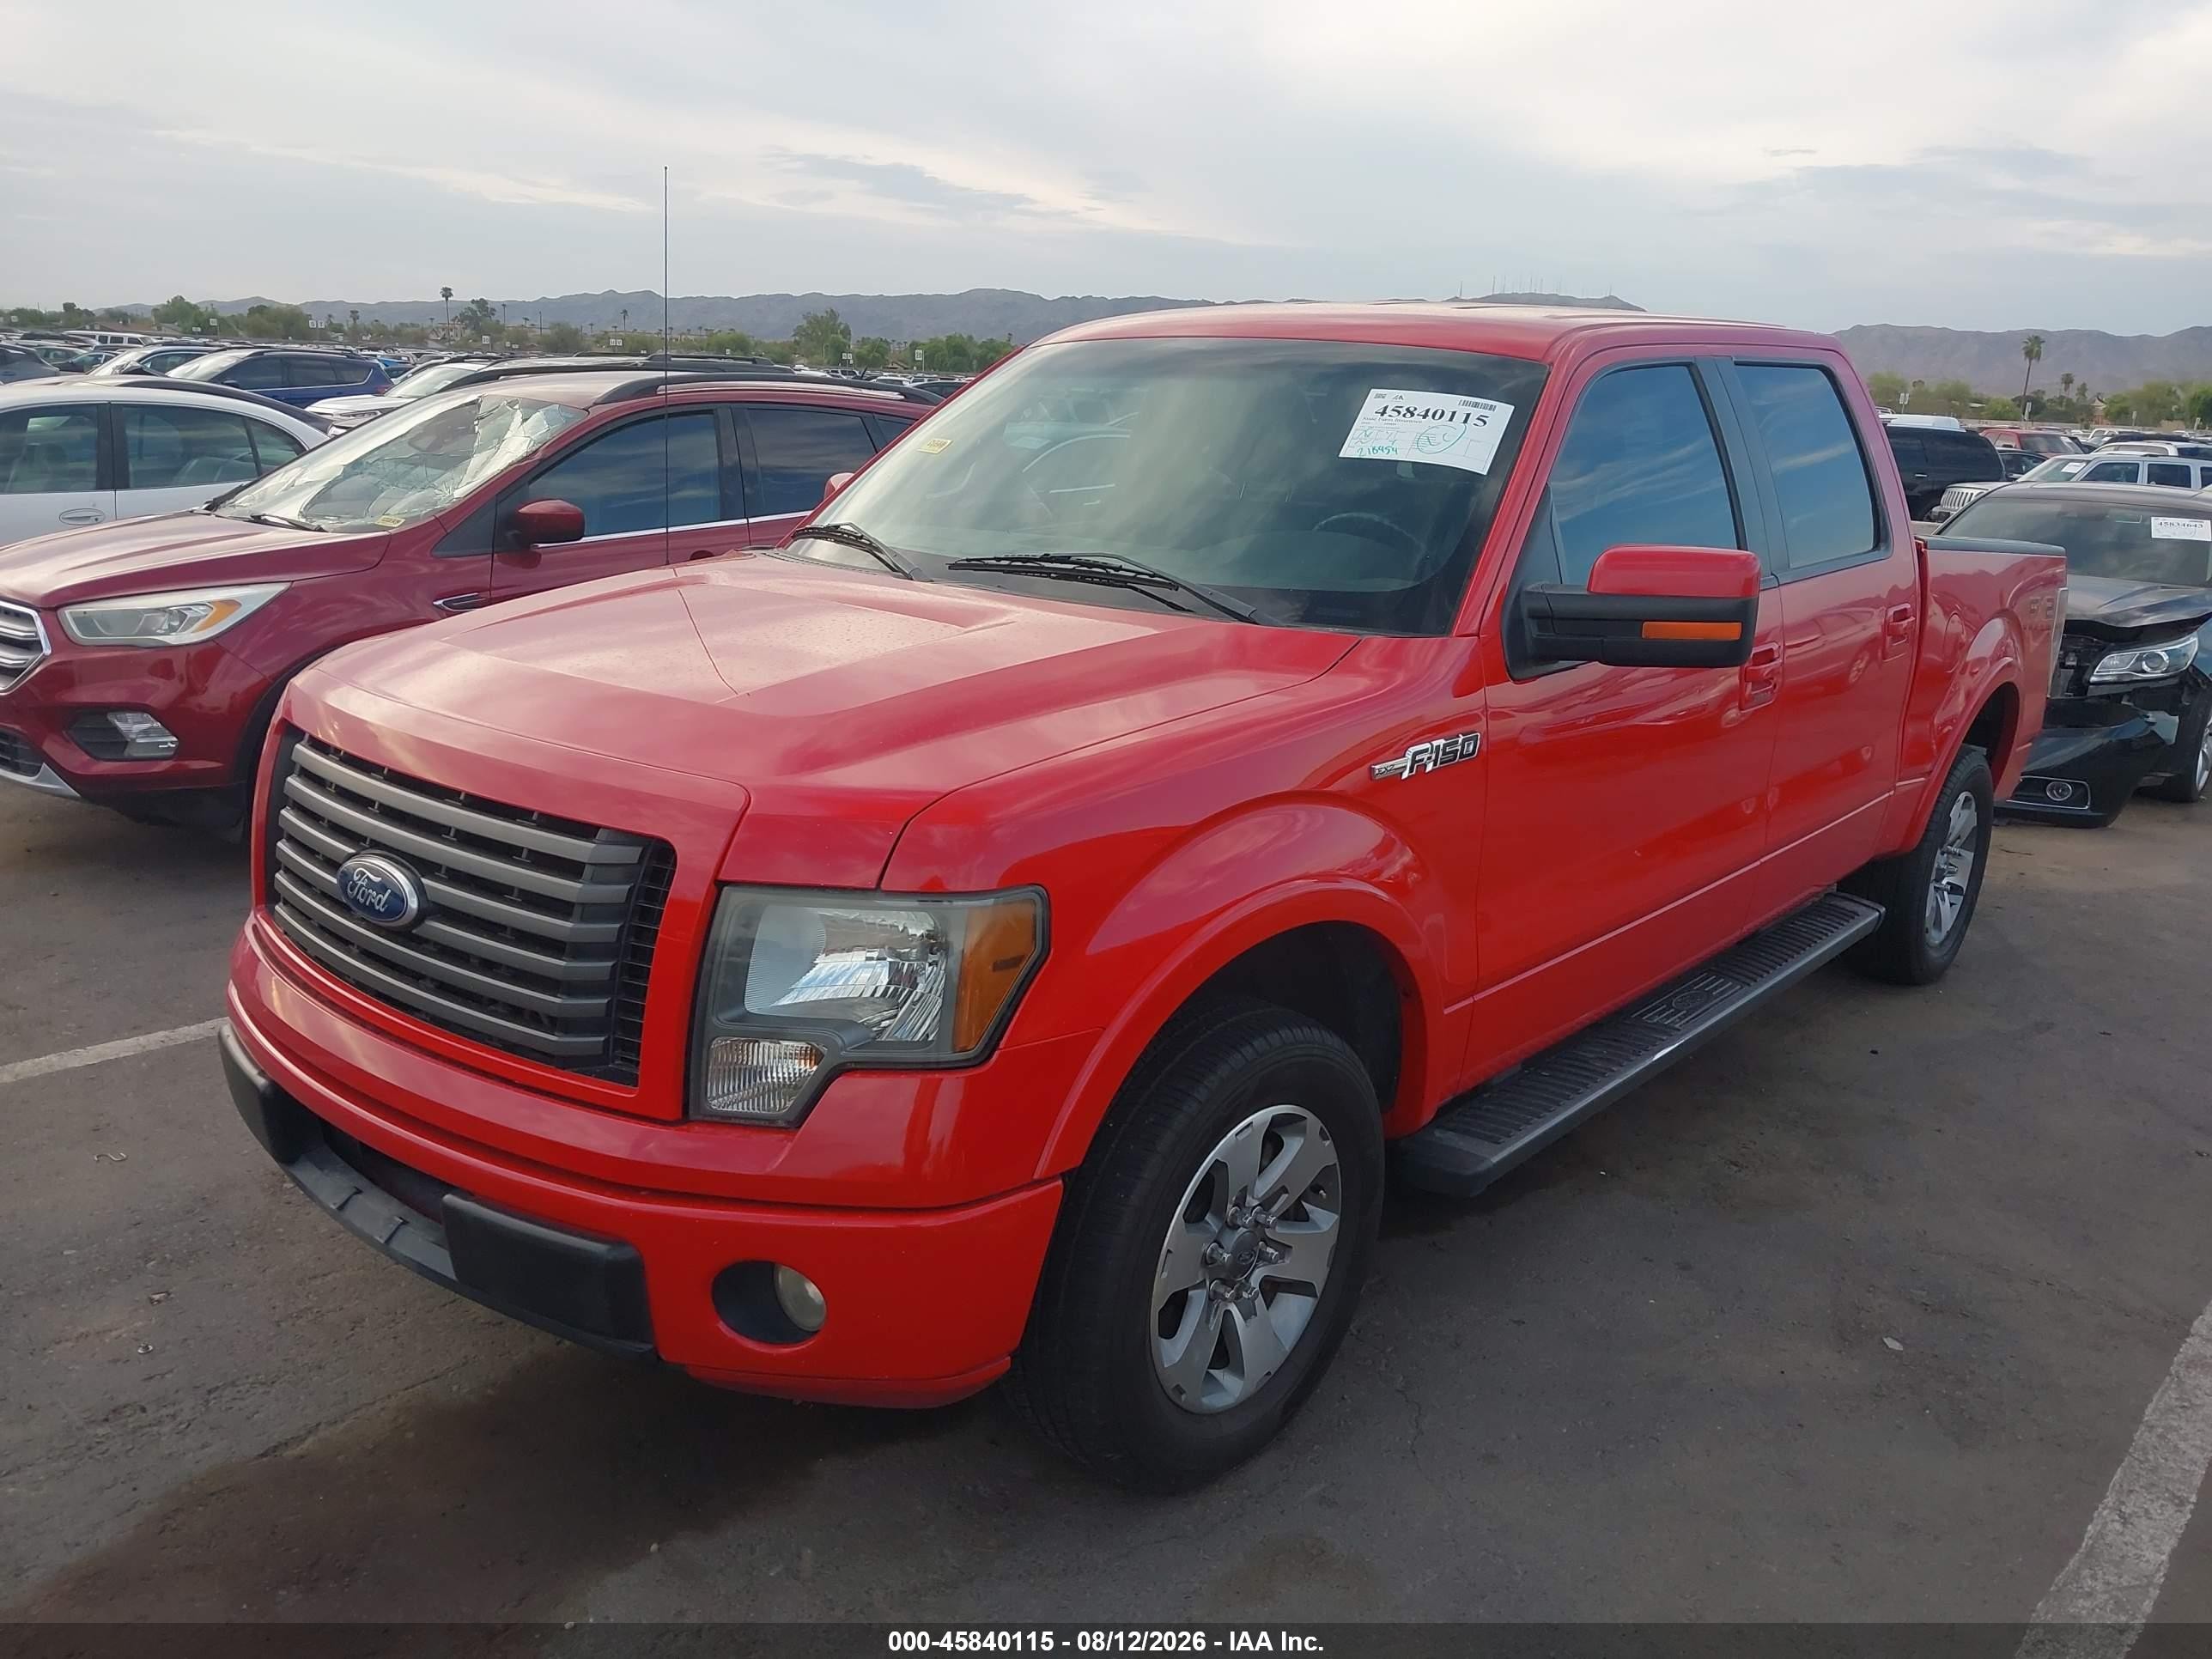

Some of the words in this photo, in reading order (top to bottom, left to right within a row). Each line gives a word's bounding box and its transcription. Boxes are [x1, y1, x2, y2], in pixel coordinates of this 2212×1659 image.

[1375, 404, 1490, 428] 45840115
[1401, 732, 1481, 779] F-150
[347, 867, 392, 912] Ford
